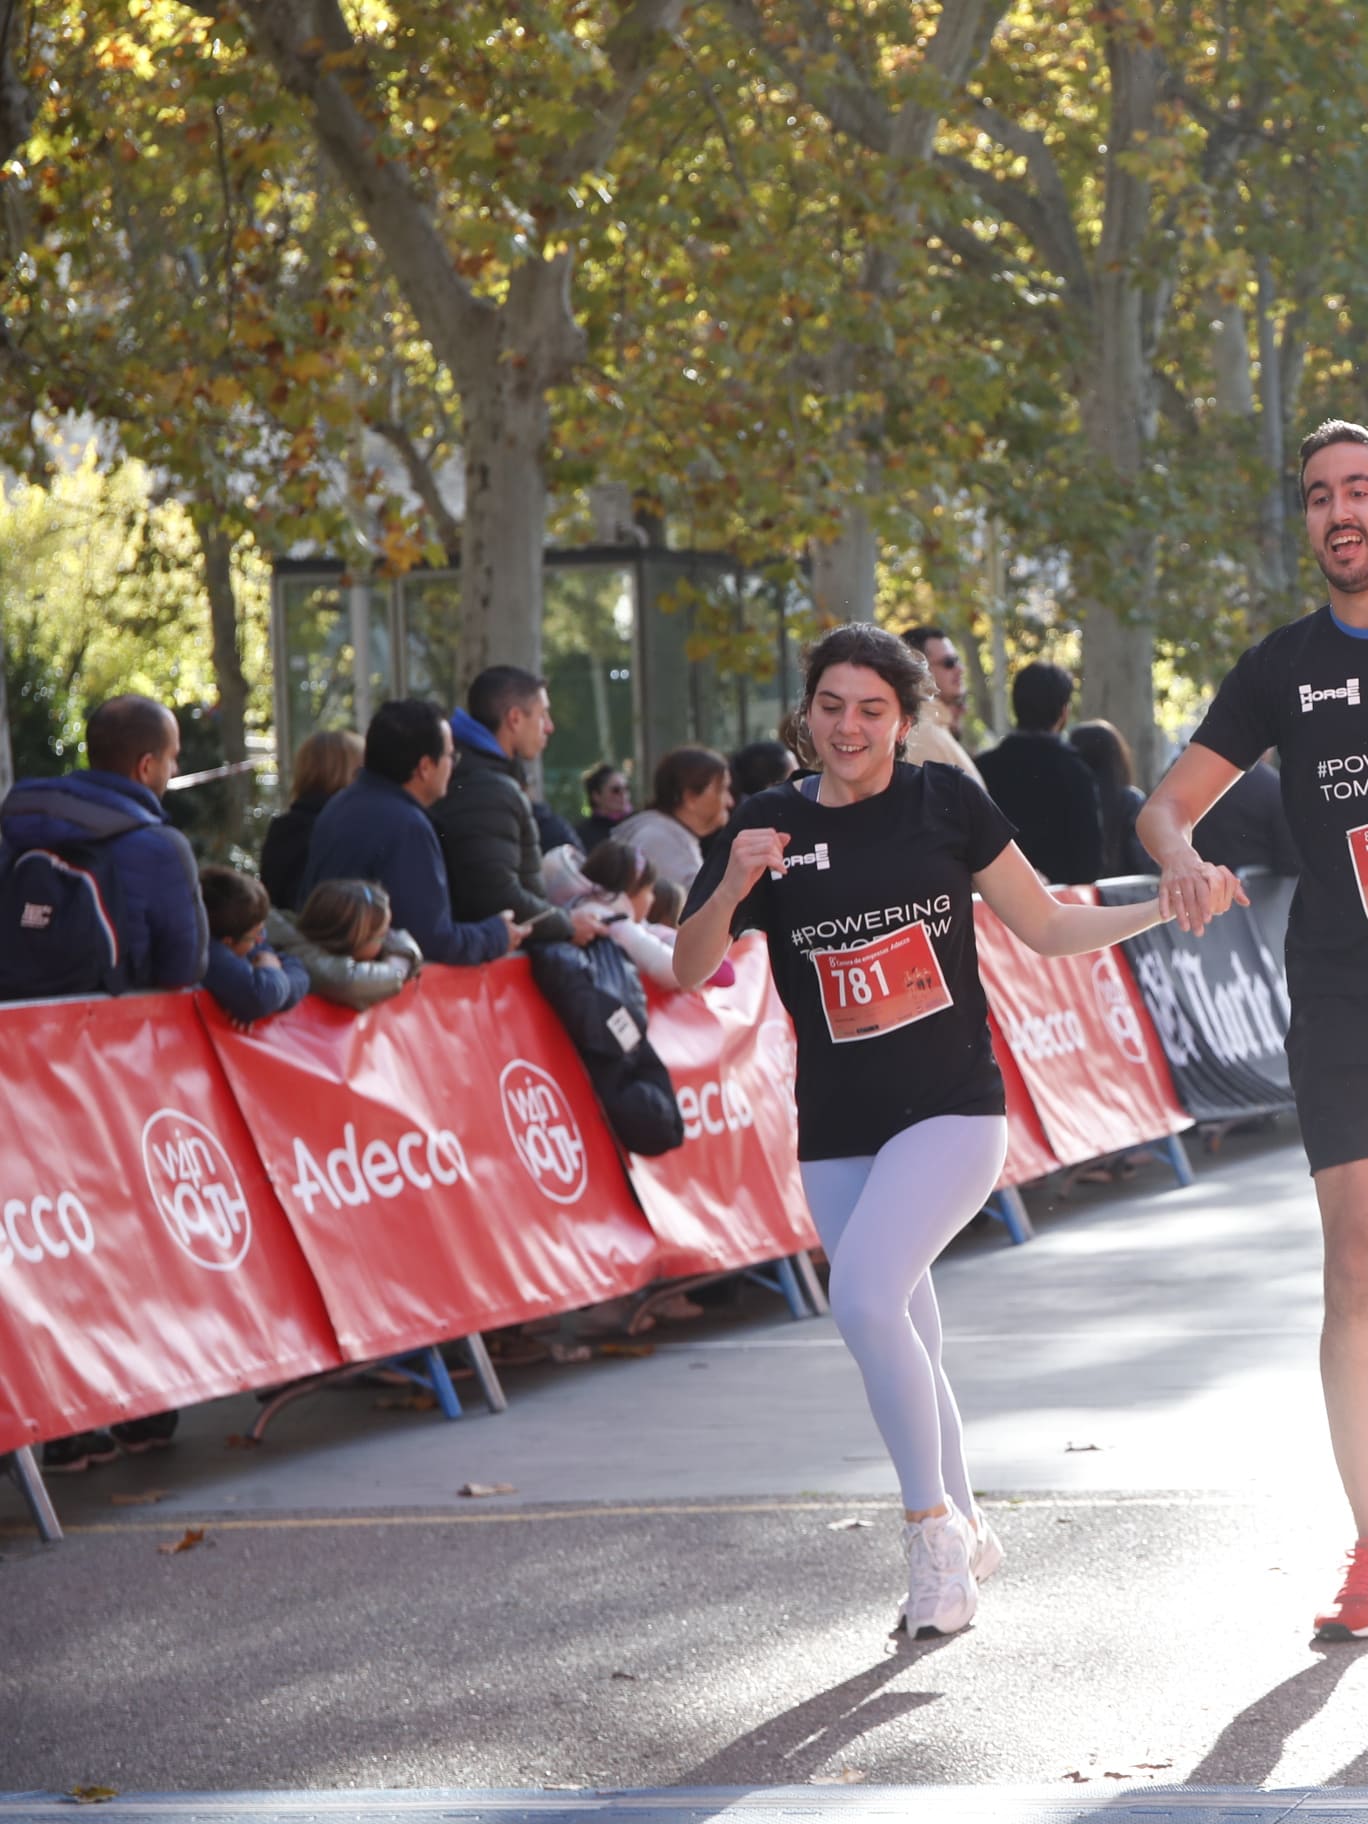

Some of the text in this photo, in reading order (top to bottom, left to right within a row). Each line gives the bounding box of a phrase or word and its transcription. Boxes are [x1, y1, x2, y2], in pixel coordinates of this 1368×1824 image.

[1299, 678, 1360, 712] HORSE
[772, 843, 830, 879] ORSE
[791, 895, 950, 946] #POWERING
[831, 960, 890, 1008] 781
[291, 1122, 468, 1213] Adecco
